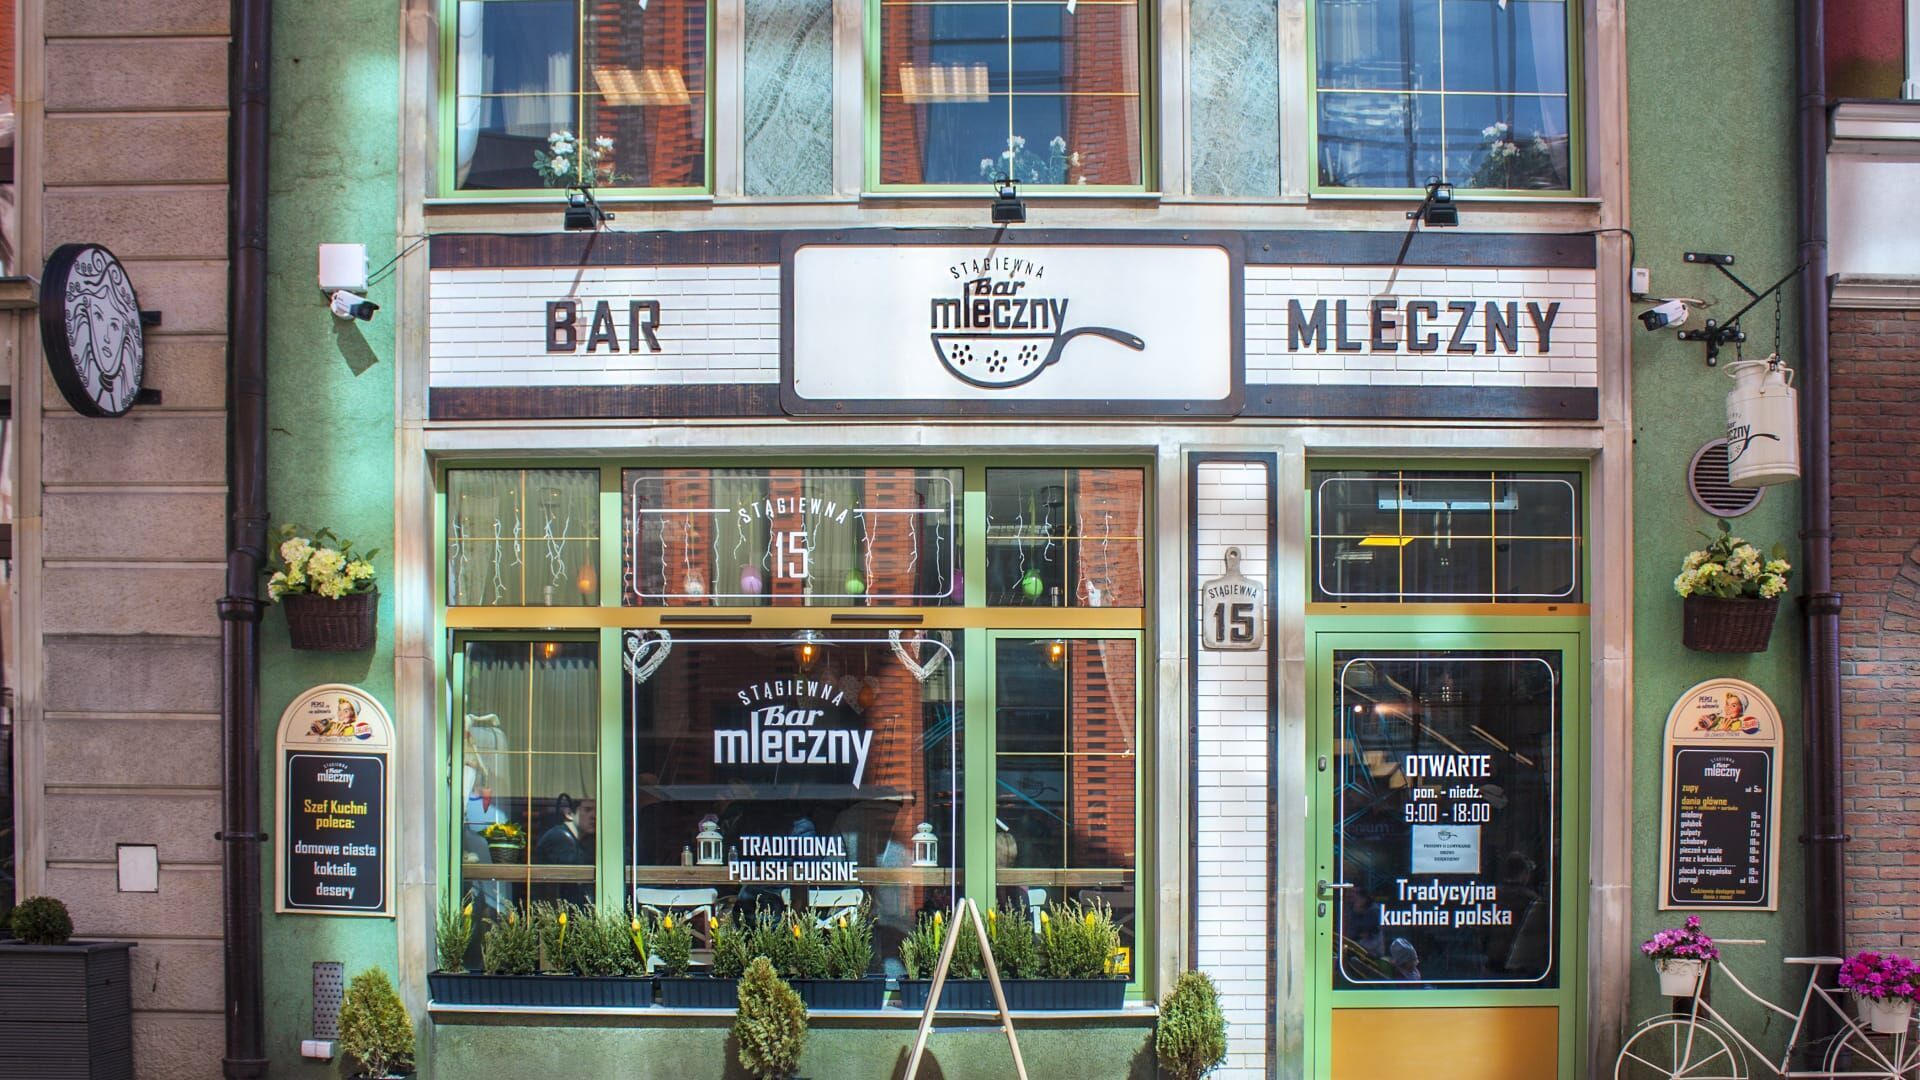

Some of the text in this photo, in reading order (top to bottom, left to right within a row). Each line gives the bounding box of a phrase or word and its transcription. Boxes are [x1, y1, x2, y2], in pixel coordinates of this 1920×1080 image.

[949, 256, 1045, 279] STĄGIEWNA
[968, 277, 1025, 296] Bar
[931, 282, 1069, 331] mleczny
[546, 299, 662, 353] BAR
[1288, 298, 1561, 354] MLECZNY
[737, 496, 850, 525] STĄGIEWNA
[775, 531, 810, 579] 15
[1207, 584, 1258, 599] STĄGIEWNA
[1213, 602, 1254, 643] 15
[737, 680, 846, 707] STĄGIEWNA
[756, 704, 826, 727] Bar
[713, 711, 874, 790] mleczny
[1405, 754, 1492, 778] OTWARTE
[1704, 764, 1741, 783] mleczny
[317, 769, 355, 789] mleczny
[1682, 785, 1699, 793] zupy
[1413, 786, 1438, 801] pon.
[1449, 784, 1483, 799] niedz.
[304, 799, 368, 816] Szef Kuchni
[1405, 803, 1438, 822] 9:00
[1453, 803, 1491, 822] 18:00
[315, 814, 356, 830] poleca:
[295, 840, 377, 857] domowe ciasta
[739, 835, 847, 857] TRADITIONAL
[313, 861, 357, 877] koktaile
[728, 861, 859, 882] POLISH CUISINE
[315, 881, 356, 900] desery
[1396, 879, 1496, 906] Tradycyjna
[1380, 904, 1513, 928] kuchnia polska
